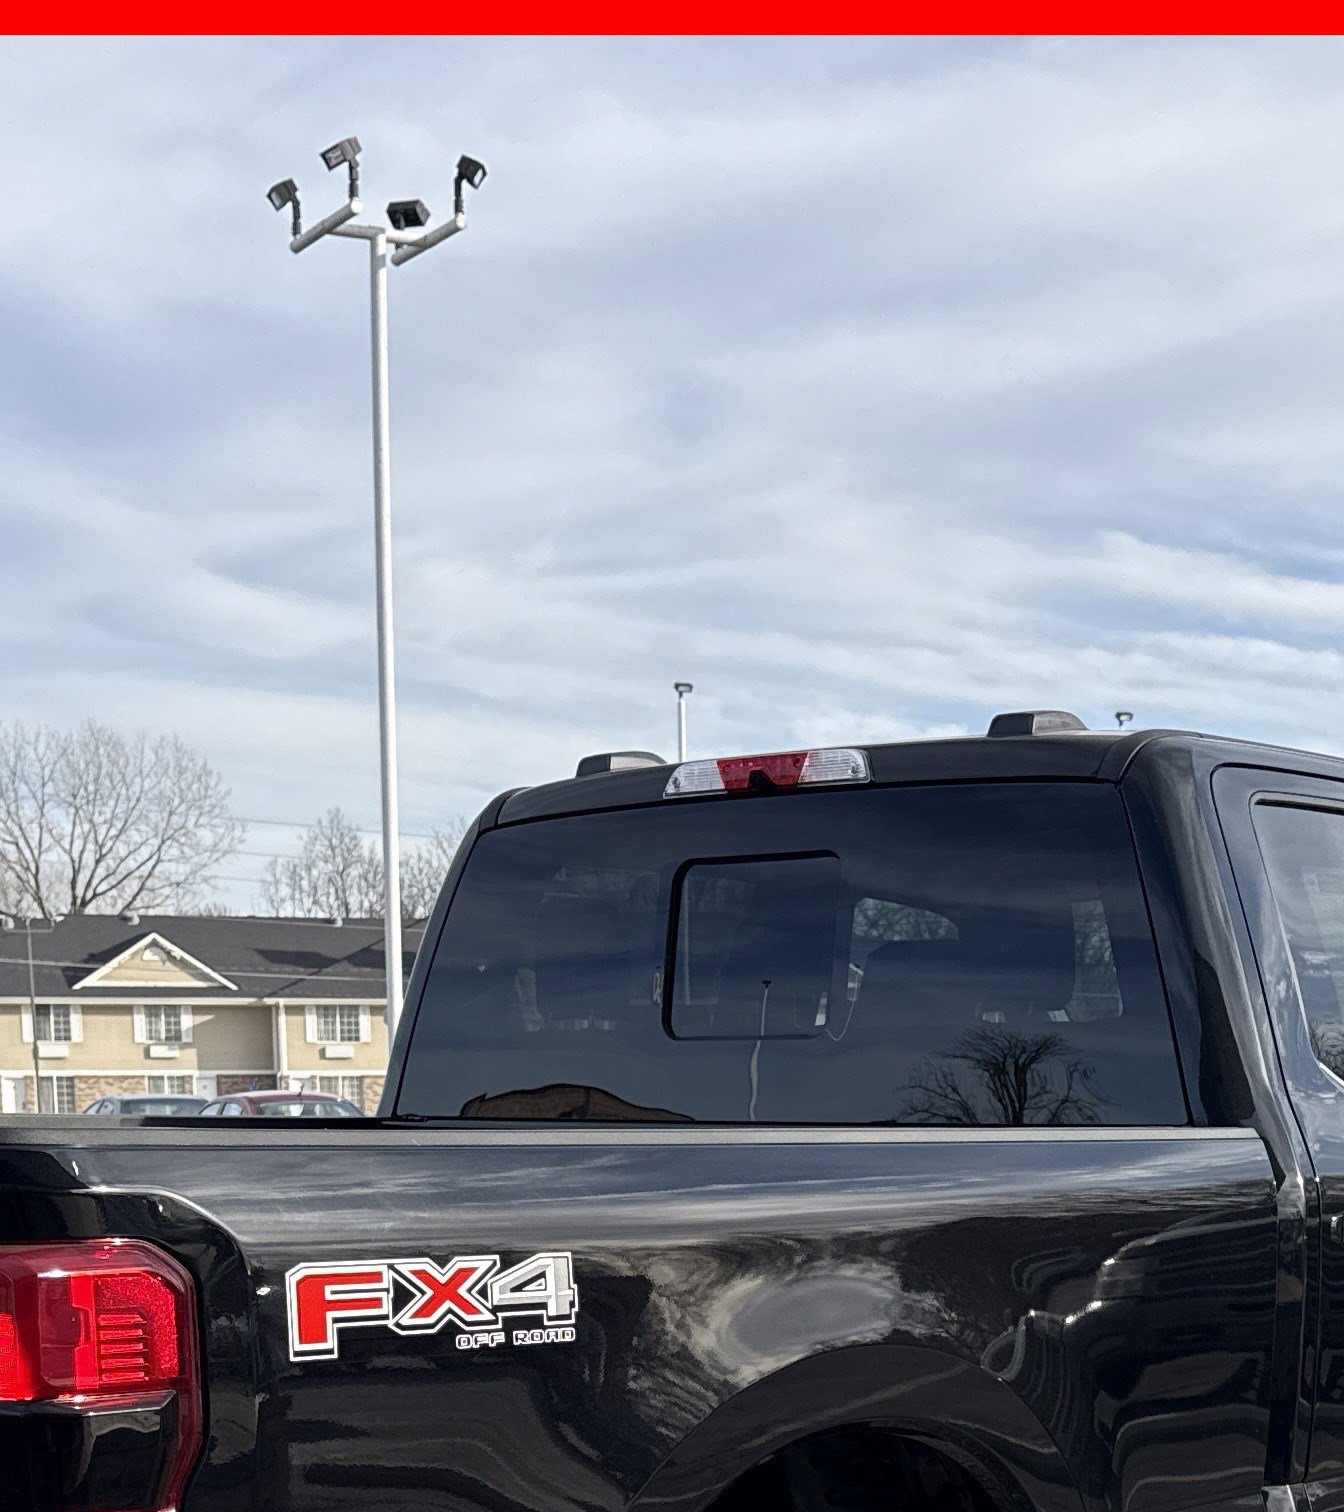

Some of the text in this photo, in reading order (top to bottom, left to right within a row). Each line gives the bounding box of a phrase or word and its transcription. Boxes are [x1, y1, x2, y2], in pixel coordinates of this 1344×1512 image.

[285, 1252, 578, 1362] FX4
[456, 1327, 576, 1349] OFF ROAD
